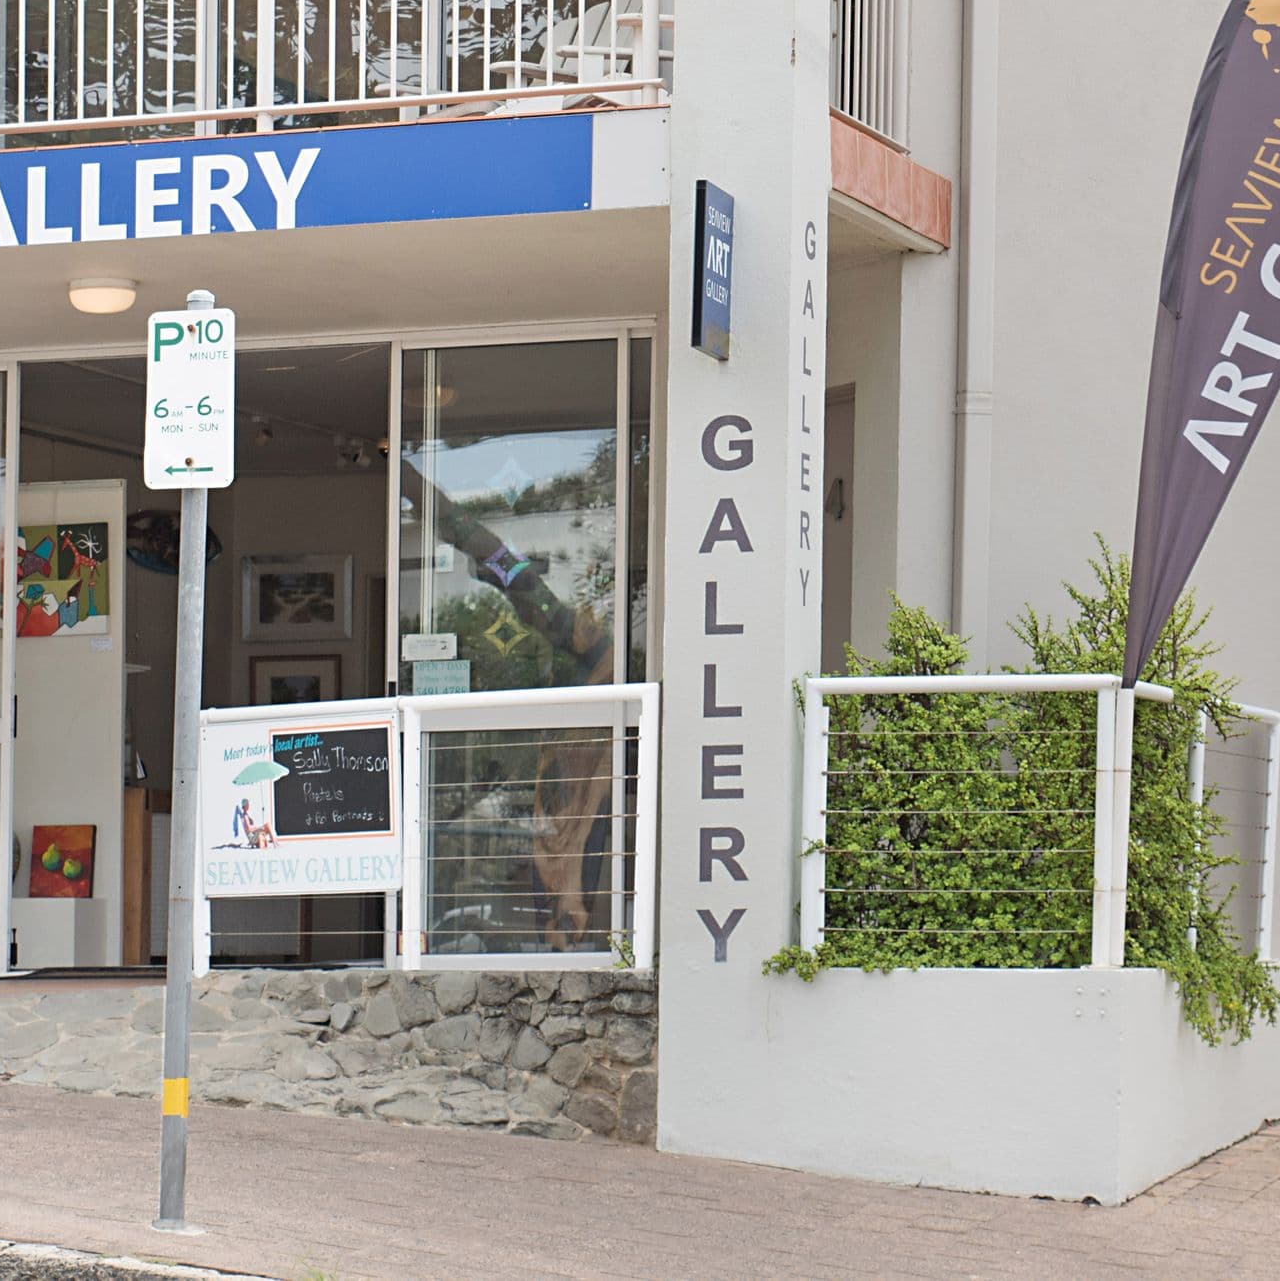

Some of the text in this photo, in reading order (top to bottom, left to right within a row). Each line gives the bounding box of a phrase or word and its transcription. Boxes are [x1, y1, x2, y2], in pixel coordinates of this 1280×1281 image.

[708, 205, 731, 234] SEAVIEW
[707, 235, 730, 278] ART
[706, 279, 729, 306] GALLERY
[154, 319, 223, 362] P 10
[189, 350, 229, 361] MINUTE
[161, 425, 184, 433] MON
[198, 423, 219, 432] SUN
[799, 221, 817, 607] GALLERY
[415, 662, 438, 671] OPEN
[448, 661, 468, 670] DAYS
[696, 415, 754, 963] GALLERY
[224, 746, 244, 761] Meet
[275, 737, 294, 751] local
[293, 748, 330, 770] Sally
[207, 854, 399, 887] SEAVIEW GALLERY
